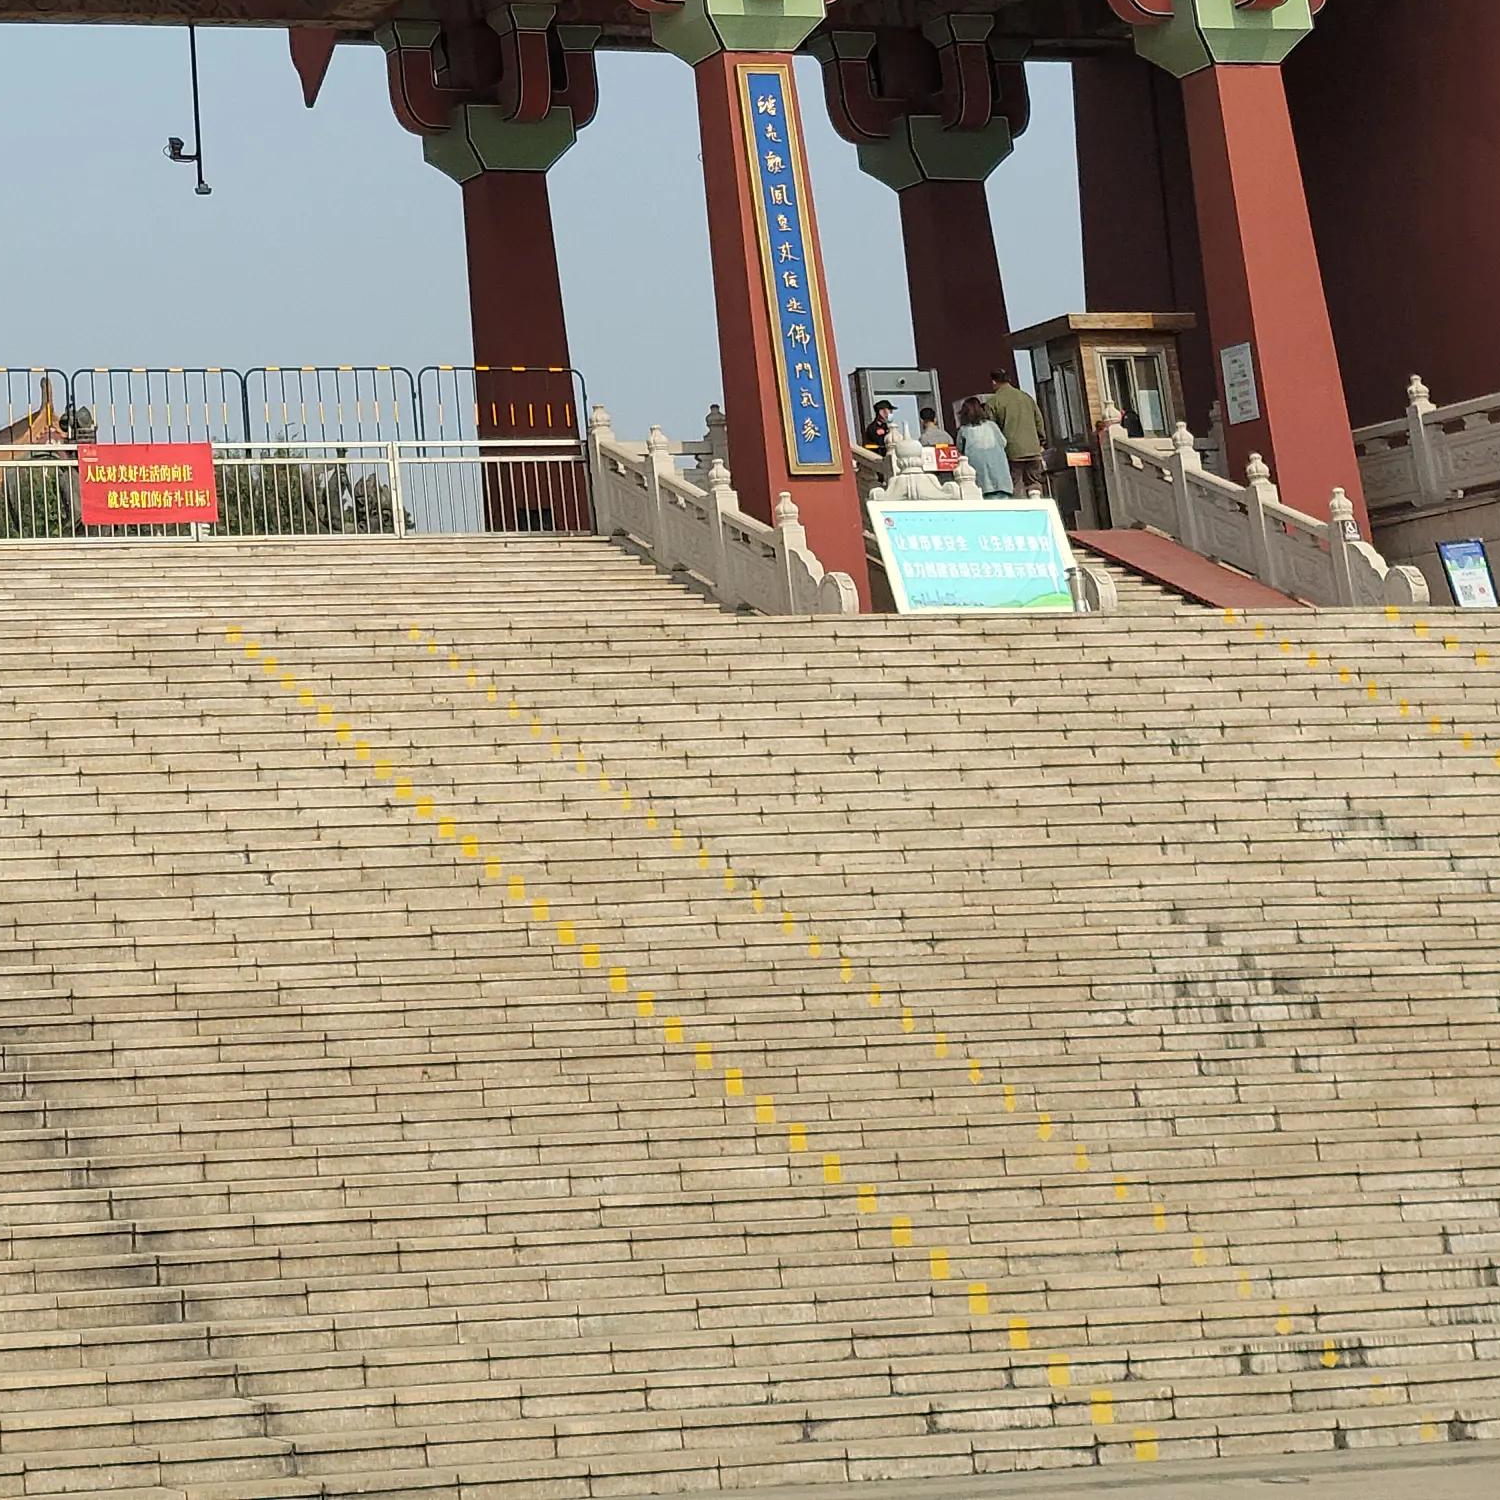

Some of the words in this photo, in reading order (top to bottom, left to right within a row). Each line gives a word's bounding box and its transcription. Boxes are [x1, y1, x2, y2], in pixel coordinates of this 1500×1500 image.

[85, 464, 193, 483] 人民对美好生活的向往
